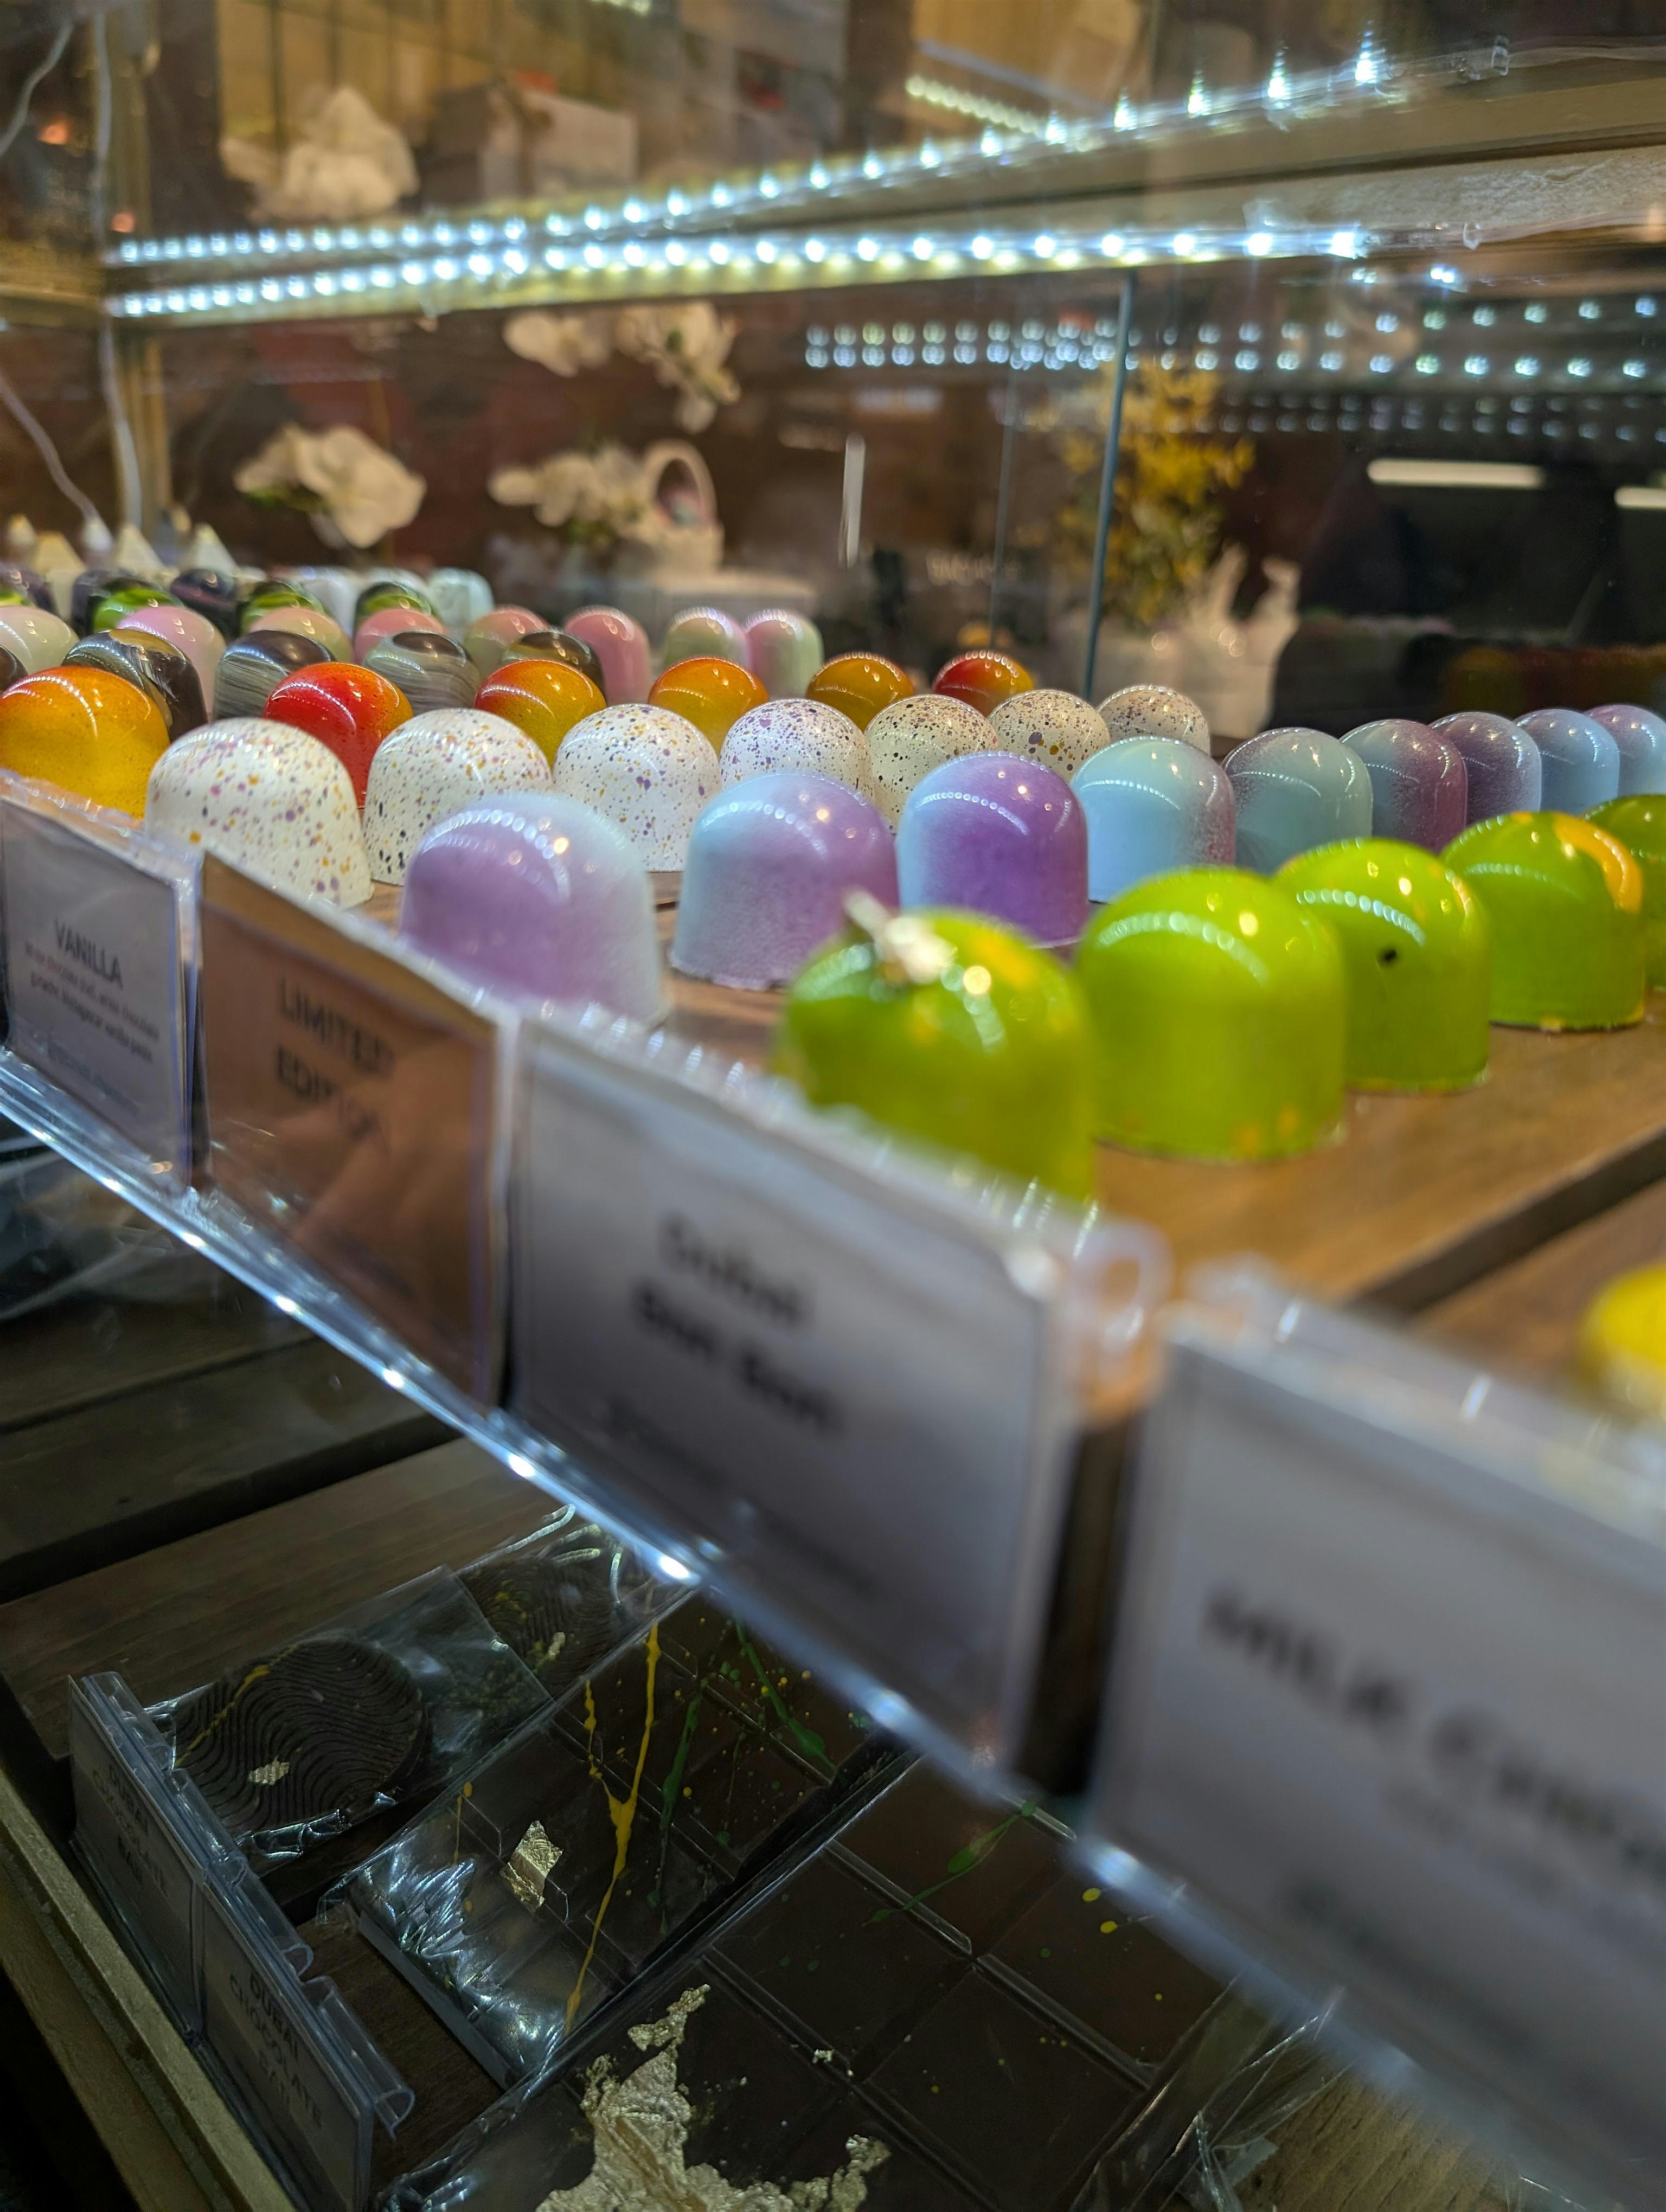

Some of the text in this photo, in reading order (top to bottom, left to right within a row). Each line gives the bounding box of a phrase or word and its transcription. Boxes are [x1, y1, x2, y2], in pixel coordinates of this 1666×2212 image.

[54, 917, 124, 988] VANILLA
[276, 977, 396, 1080] LIMITED
[108, 1764, 149, 1836] DUBAI
[229, 1974, 323, 2130] CHOCOLATE
[249, 1972, 299, 2063] DUBAI
